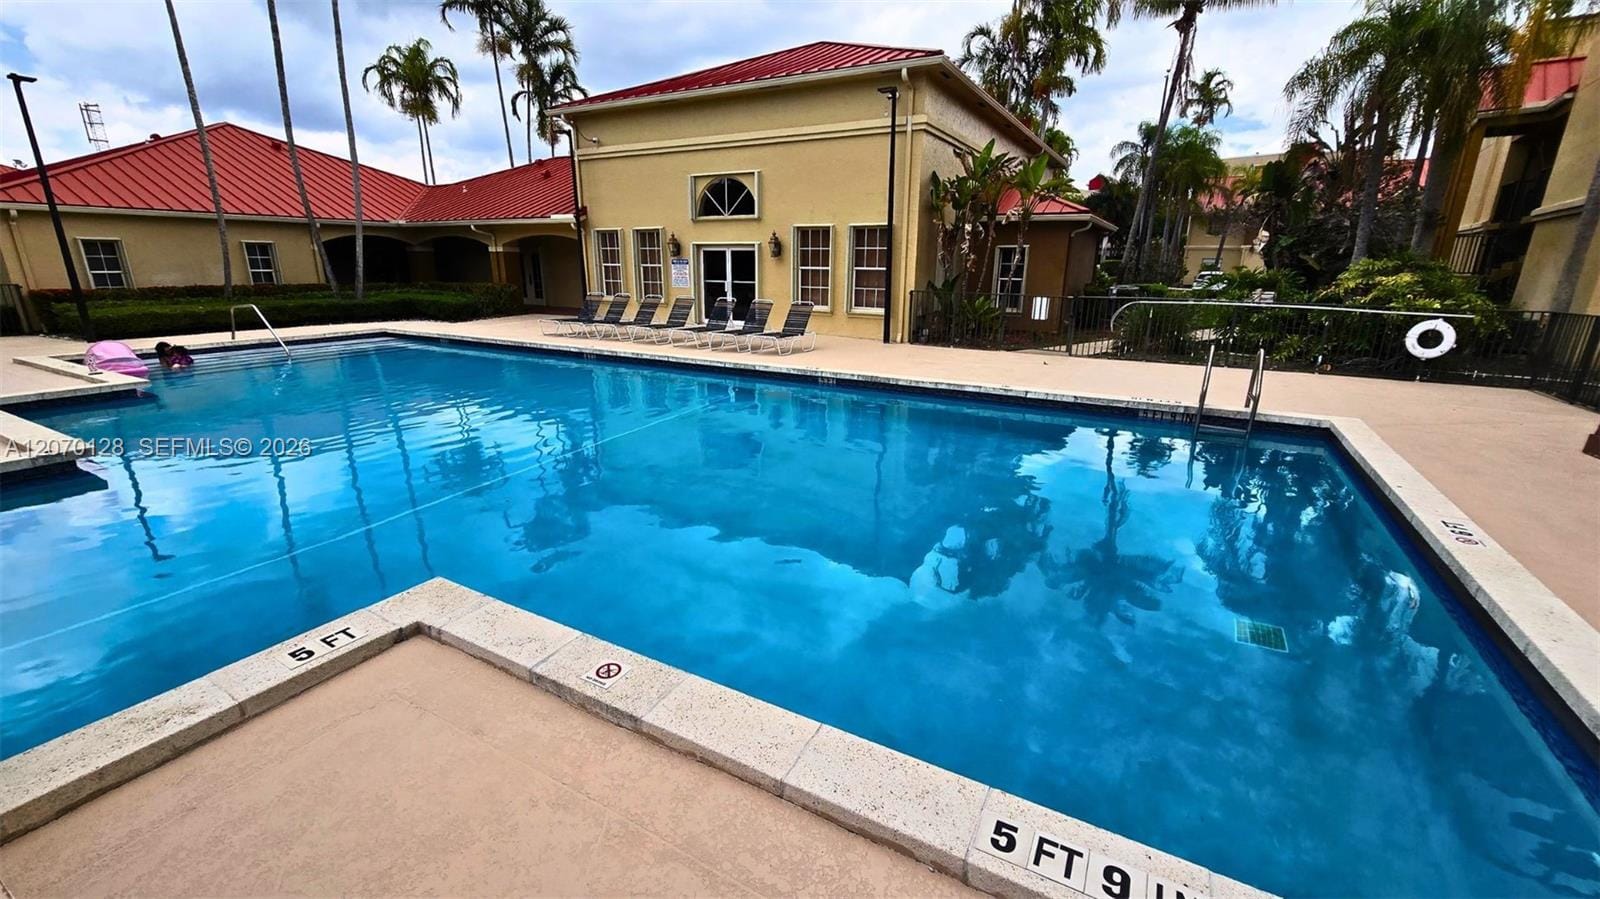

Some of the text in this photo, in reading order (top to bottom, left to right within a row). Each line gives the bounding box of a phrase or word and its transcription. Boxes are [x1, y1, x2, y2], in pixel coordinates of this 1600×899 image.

[287, 627, 356, 661] 5 FT
[990, 819, 1019, 853] 5
[1033, 836, 1083, 880] FT
[1101, 865, 1131, 899] 9
